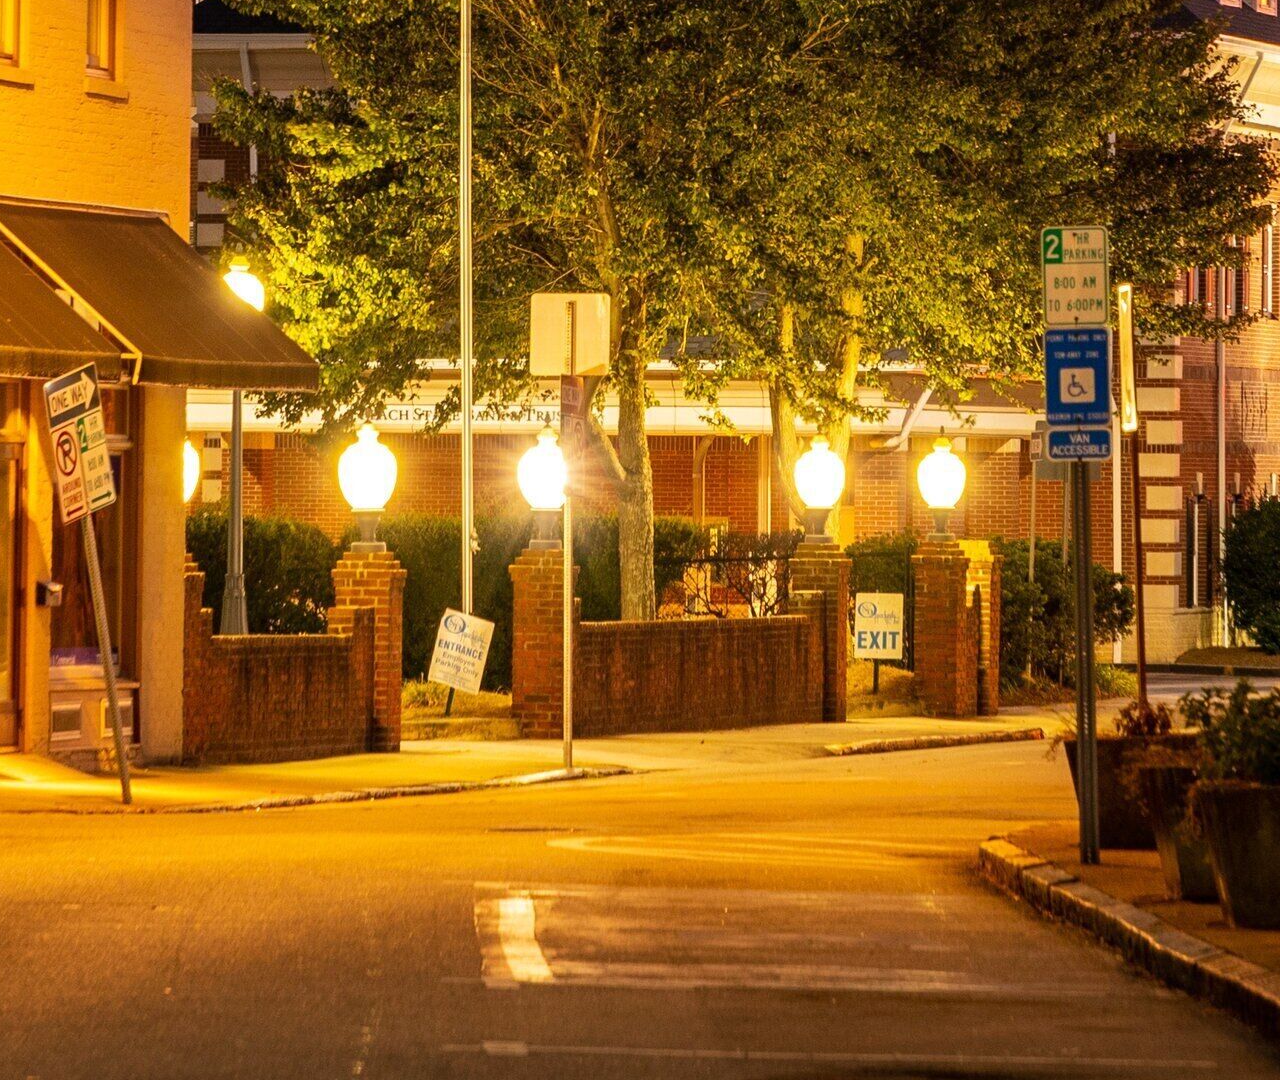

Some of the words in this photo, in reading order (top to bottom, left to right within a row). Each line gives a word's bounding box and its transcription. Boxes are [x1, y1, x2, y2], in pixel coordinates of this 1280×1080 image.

[1045, 234, 1060, 259] 2
[1076, 232, 1090, 244] HR
[1064, 248, 1104, 260] PARKING
[1054, 276, 1076, 289] 8:00
[1082, 276, 1097, 289] AM
[51, 391, 69, 413] ONE
[71, 381, 88, 403] WAY
[412, 407, 461, 421] STE
[471, 407, 506, 421] ANK
[524, 406, 561, 422] TRUS
[78, 424, 87, 447] 2
[1069, 433, 1090, 444] VAN
[1052, 445, 1109, 456] ACCESSIBLE
[857, 631, 900, 650] EXIT
[438, 640, 483, 660] ENTRANCE
[442, 651, 475, 667] Employee
[435, 657, 461, 674] Parking
[463, 667, 479, 679] Only
